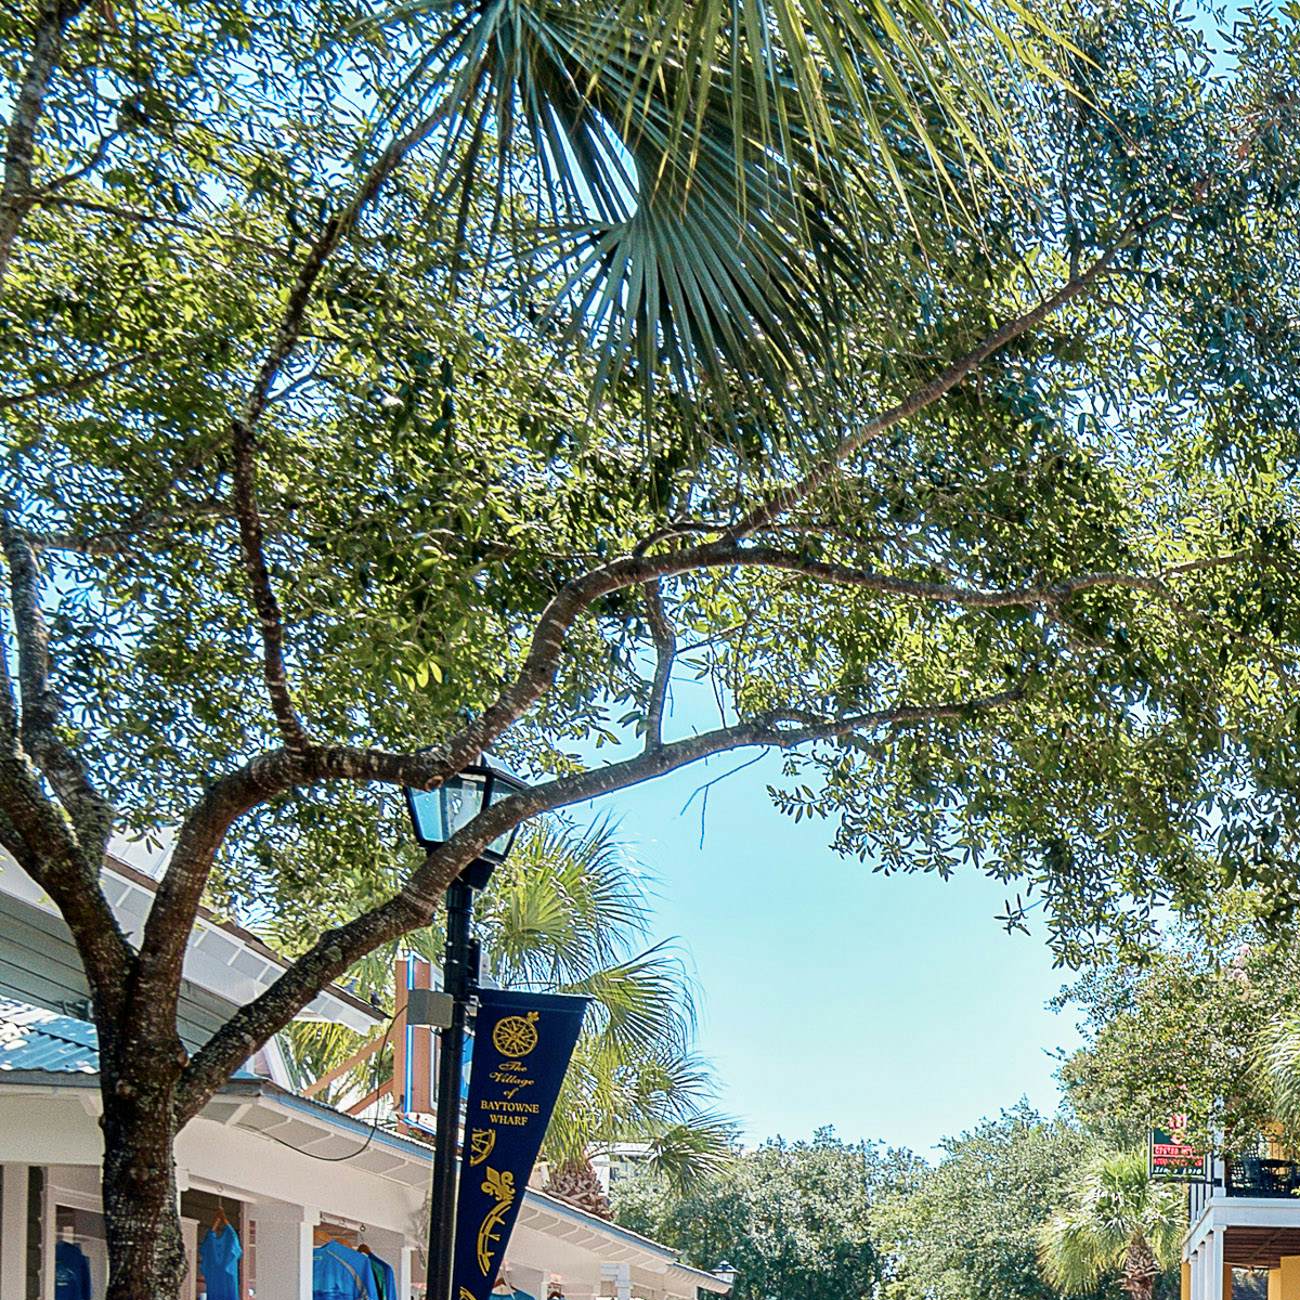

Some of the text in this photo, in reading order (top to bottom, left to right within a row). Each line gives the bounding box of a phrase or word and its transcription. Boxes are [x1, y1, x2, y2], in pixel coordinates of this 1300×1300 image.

[498, 1061, 528, 1072] The
[489, 1071, 535, 1086] Village
[503, 1087, 519, 1099] of
[480, 1100, 540, 1114] BAYTOWNE
[490, 1114, 529, 1126] WHARF
